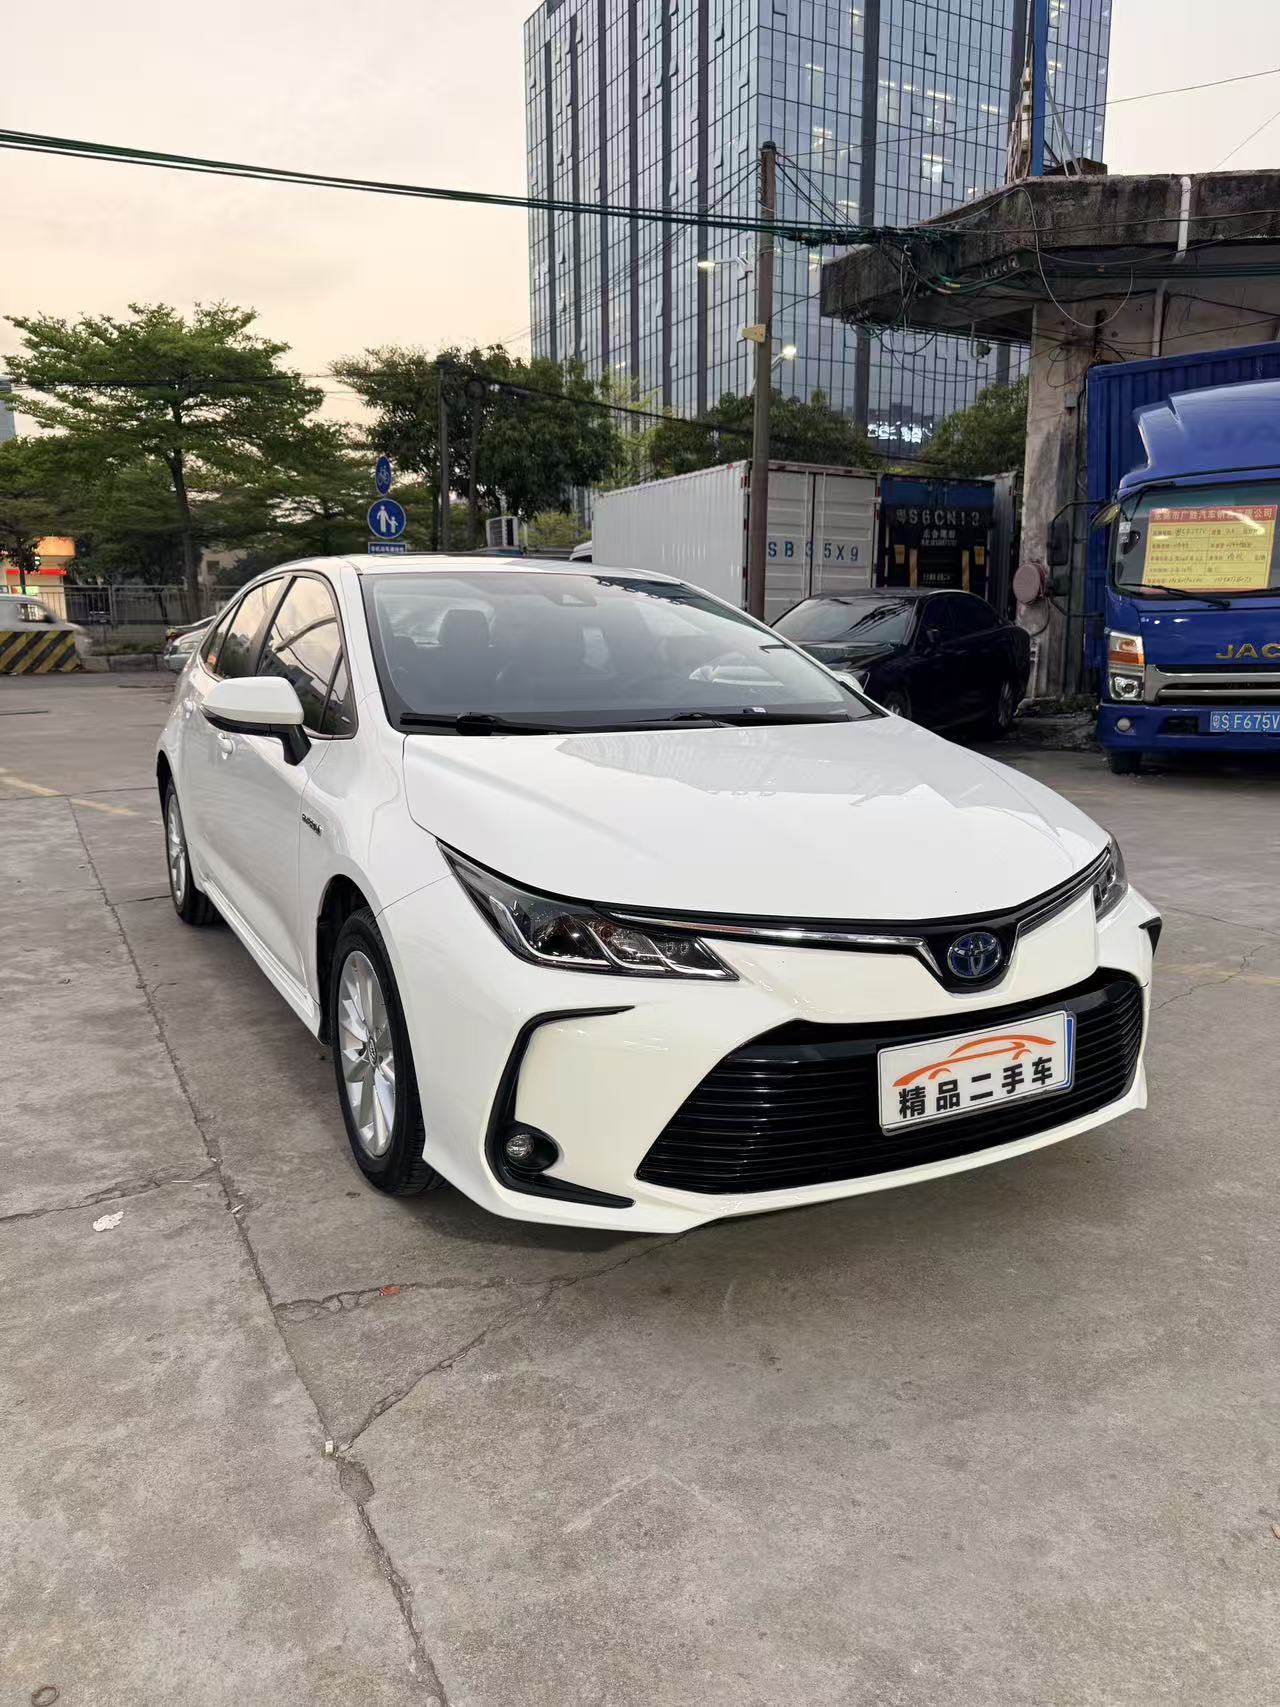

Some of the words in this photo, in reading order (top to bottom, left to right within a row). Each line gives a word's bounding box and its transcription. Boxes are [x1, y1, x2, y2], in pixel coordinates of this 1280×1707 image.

[1215, 643, 1280, 659] JAC
[899, 1056, 1053, 1119] 精品二手车
